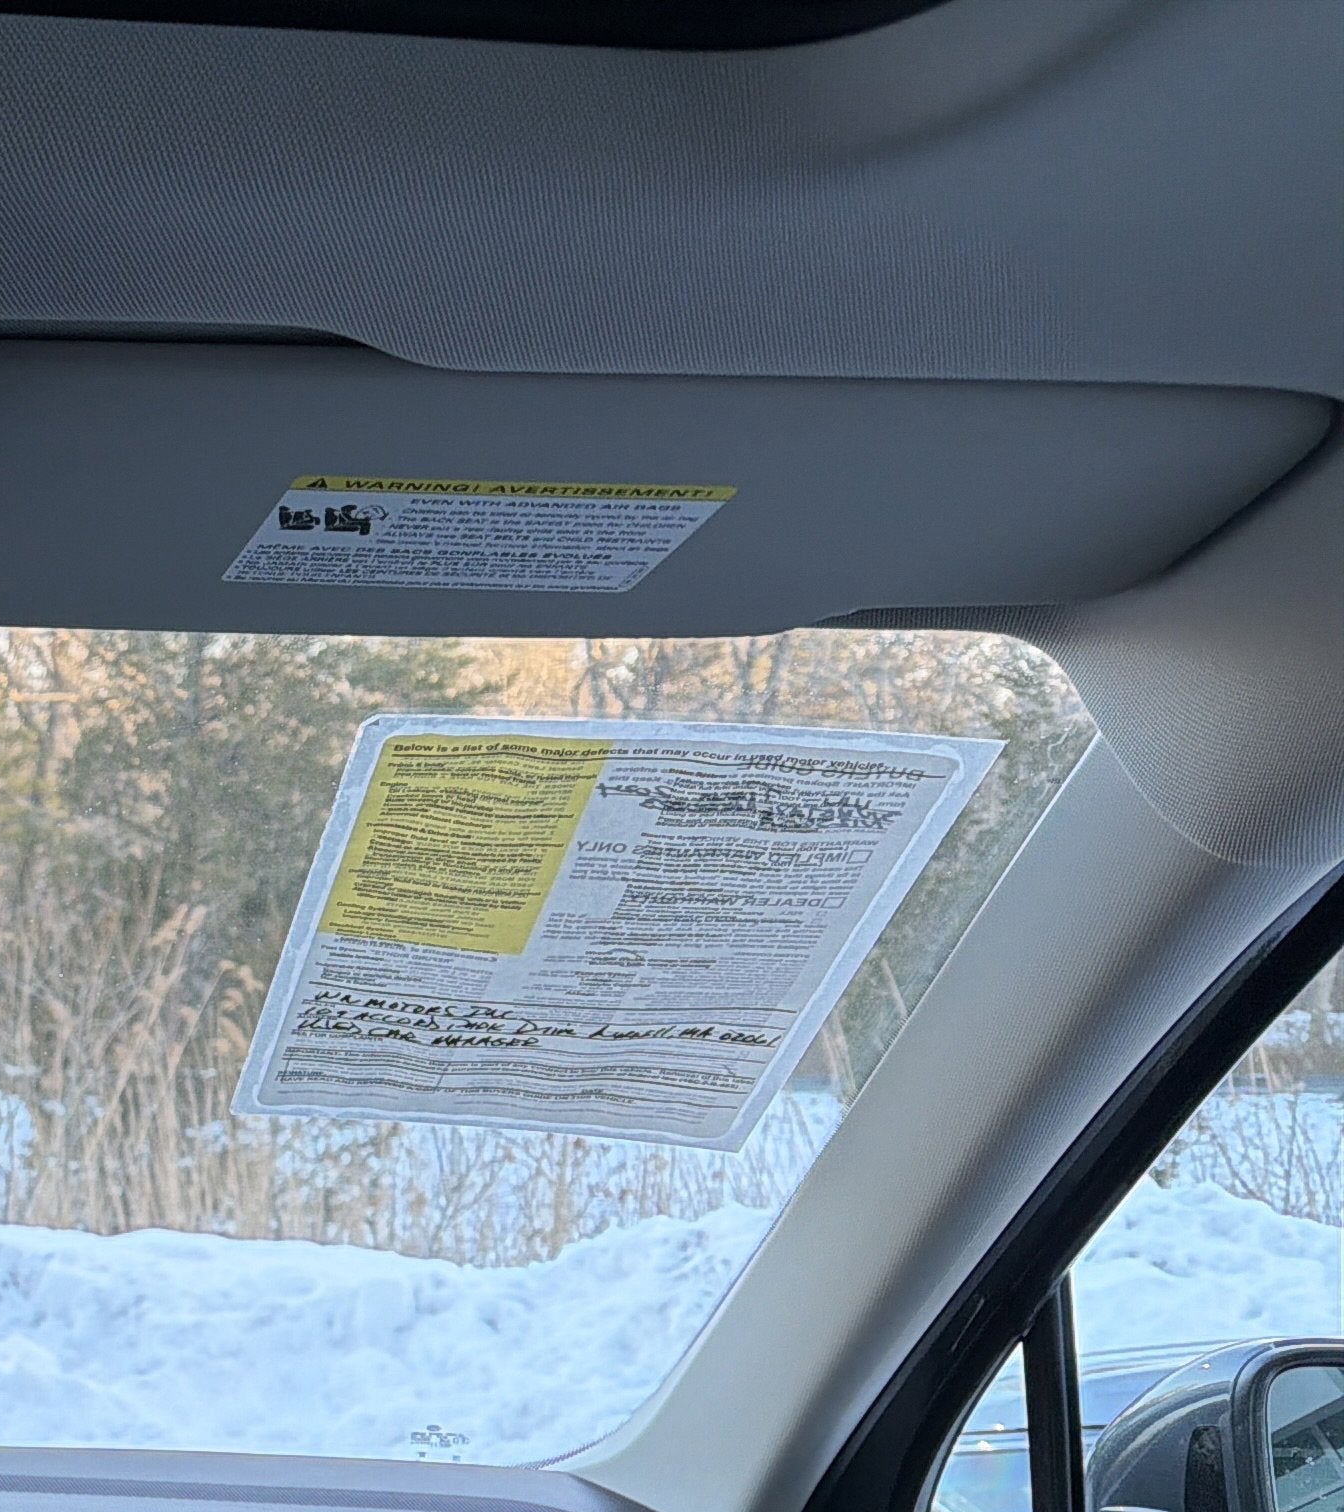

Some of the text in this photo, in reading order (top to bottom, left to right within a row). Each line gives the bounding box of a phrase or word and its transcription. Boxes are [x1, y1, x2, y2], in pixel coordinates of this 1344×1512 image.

[345, 480, 714, 497] WARNING! AVERTISSEMENT!
[459, 499, 502, 507] WITH
[393, 743, 435, 752] Below
[437, 744, 448, 752] is
[462, 743, 483, 752] list
[486, 743, 501, 751] of
[501, 743, 538, 753] some
[541, 748, 579, 758] major
[581, 747, 629, 757] defects
[632, 747, 659, 755] that
[661, 749, 689, 758] may
[693, 750, 731, 761] occur
[734, 753, 746, 762] in
[749, 752, 784, 763] used
[786, 756, 826, 767] motor
